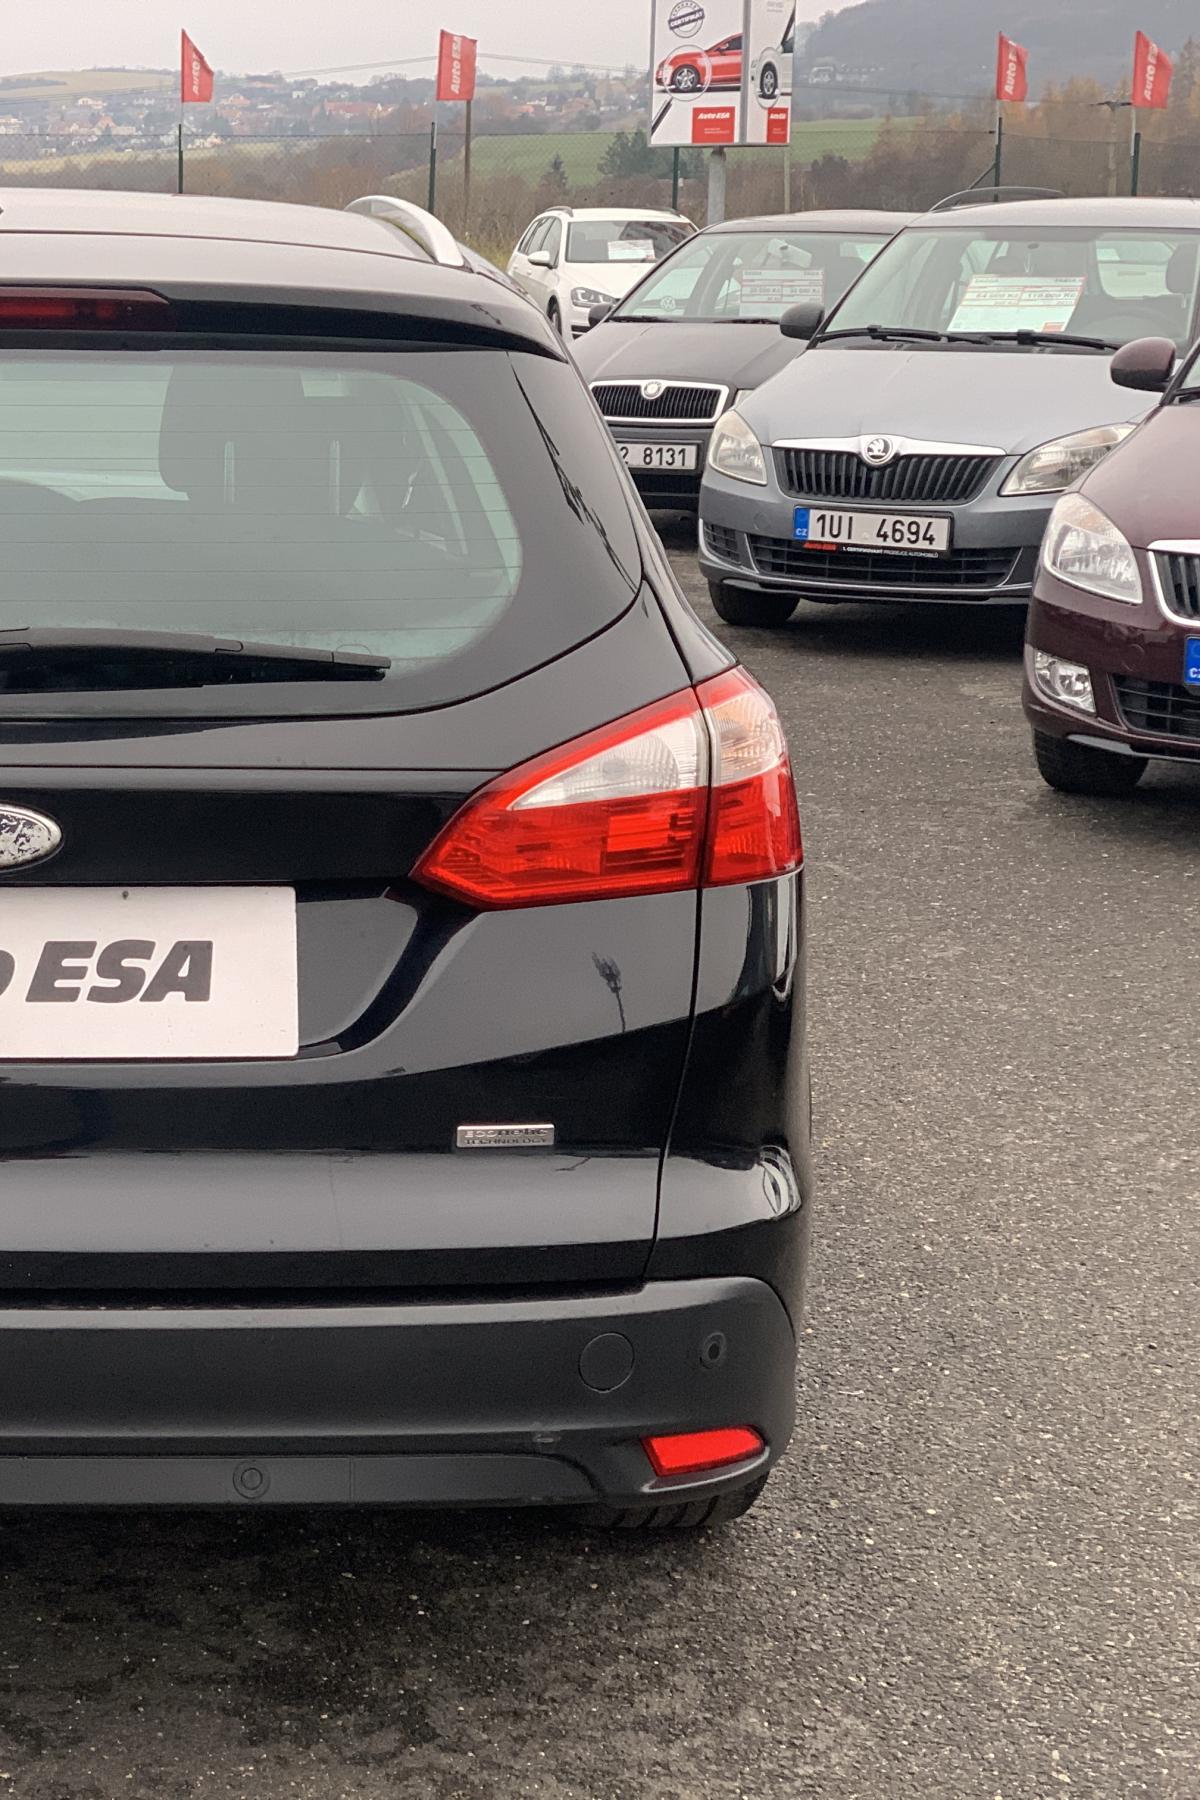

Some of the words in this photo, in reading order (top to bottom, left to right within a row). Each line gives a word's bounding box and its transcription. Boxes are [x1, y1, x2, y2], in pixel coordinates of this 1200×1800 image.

[450, 60, 461, 95] Auto
[1003, 62, 1017, 96] Auto
[643, 446, 687, 467] 8131
[795, 528, 808, 537] CZ
[816, 513, 854, 540] 1UI
[875, 518, 936, 546] 4694
[25, 939, 214, 1004] ESA
